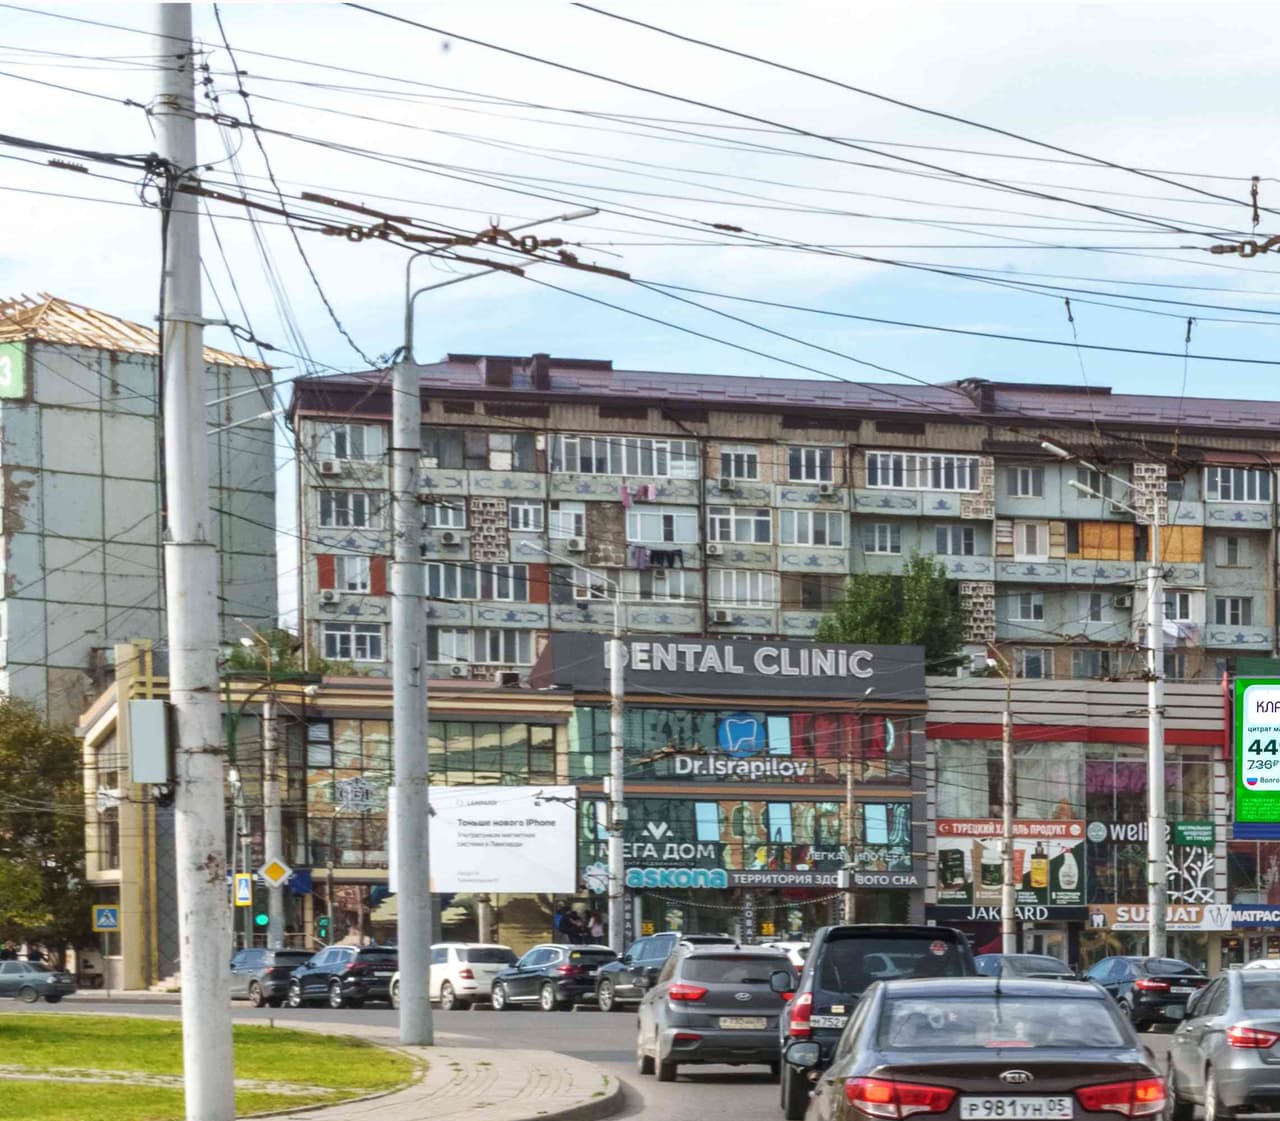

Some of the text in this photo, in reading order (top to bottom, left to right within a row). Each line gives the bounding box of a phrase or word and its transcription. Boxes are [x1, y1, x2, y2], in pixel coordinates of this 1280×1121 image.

[753, 646, 874, 678] CLINIC
[674, 756, 808, 780] Dr.Israpilov
[952, 822, 1067, 838] ТУРЕЦКИЙ ХАЯЛЬ ПРОДУКТ
[663, 844, 715, 860] ДОМ
[626, 867, 728, 889] askona
[733, 873, 918, 886] ТЕРРИТОРИЯ ЗДОВОГО СНА
[967, 905, 1049, 921] JAKARD
[1047, 1098, 1066, 1112] 05
